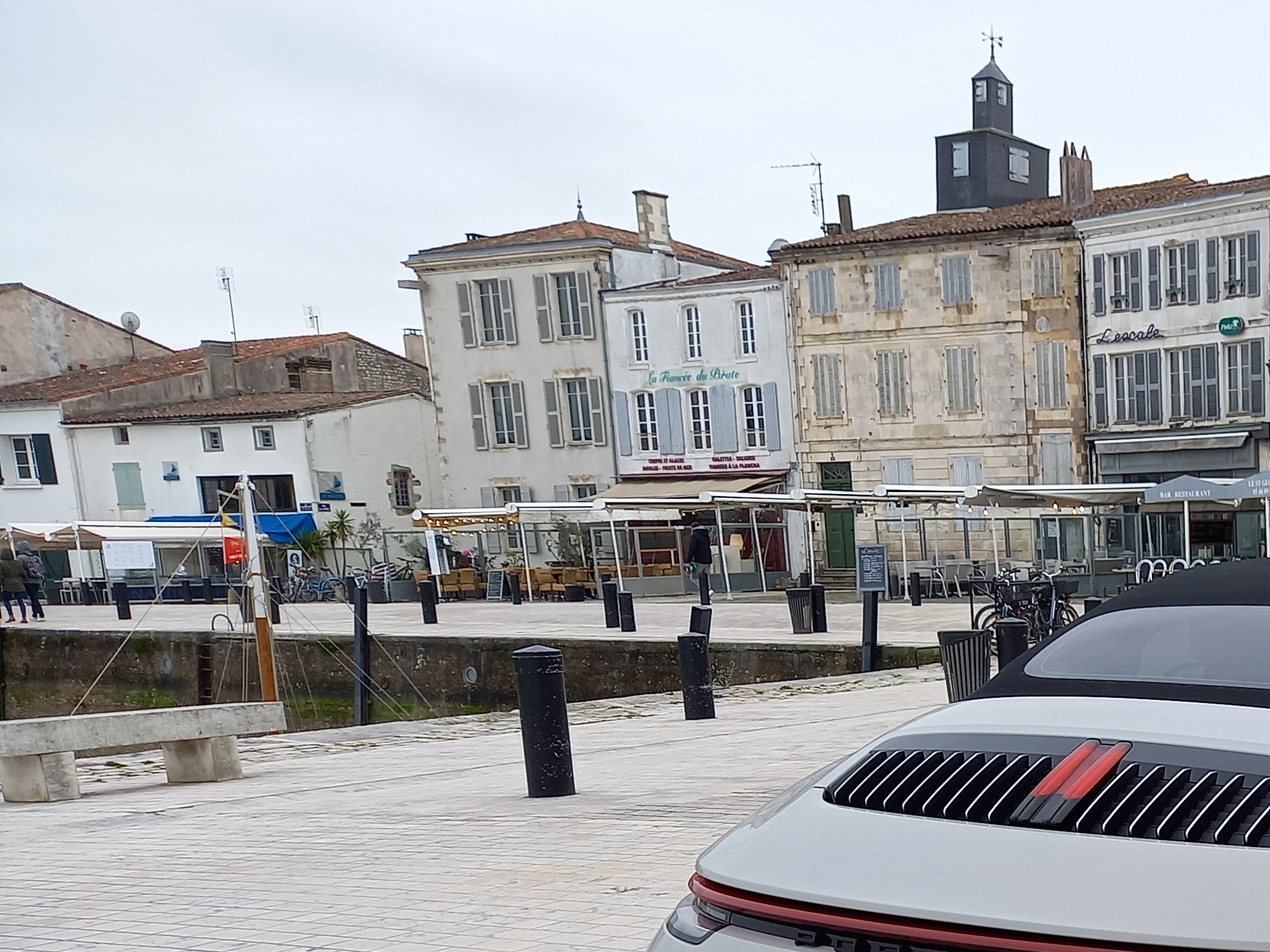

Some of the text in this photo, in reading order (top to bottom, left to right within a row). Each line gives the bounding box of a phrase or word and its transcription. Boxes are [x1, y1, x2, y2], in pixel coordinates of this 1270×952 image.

[646, 369, 657, 386] La
[696, 368, 708, 381] du
[1174, 489, 1211, 498] RESTAURANT
